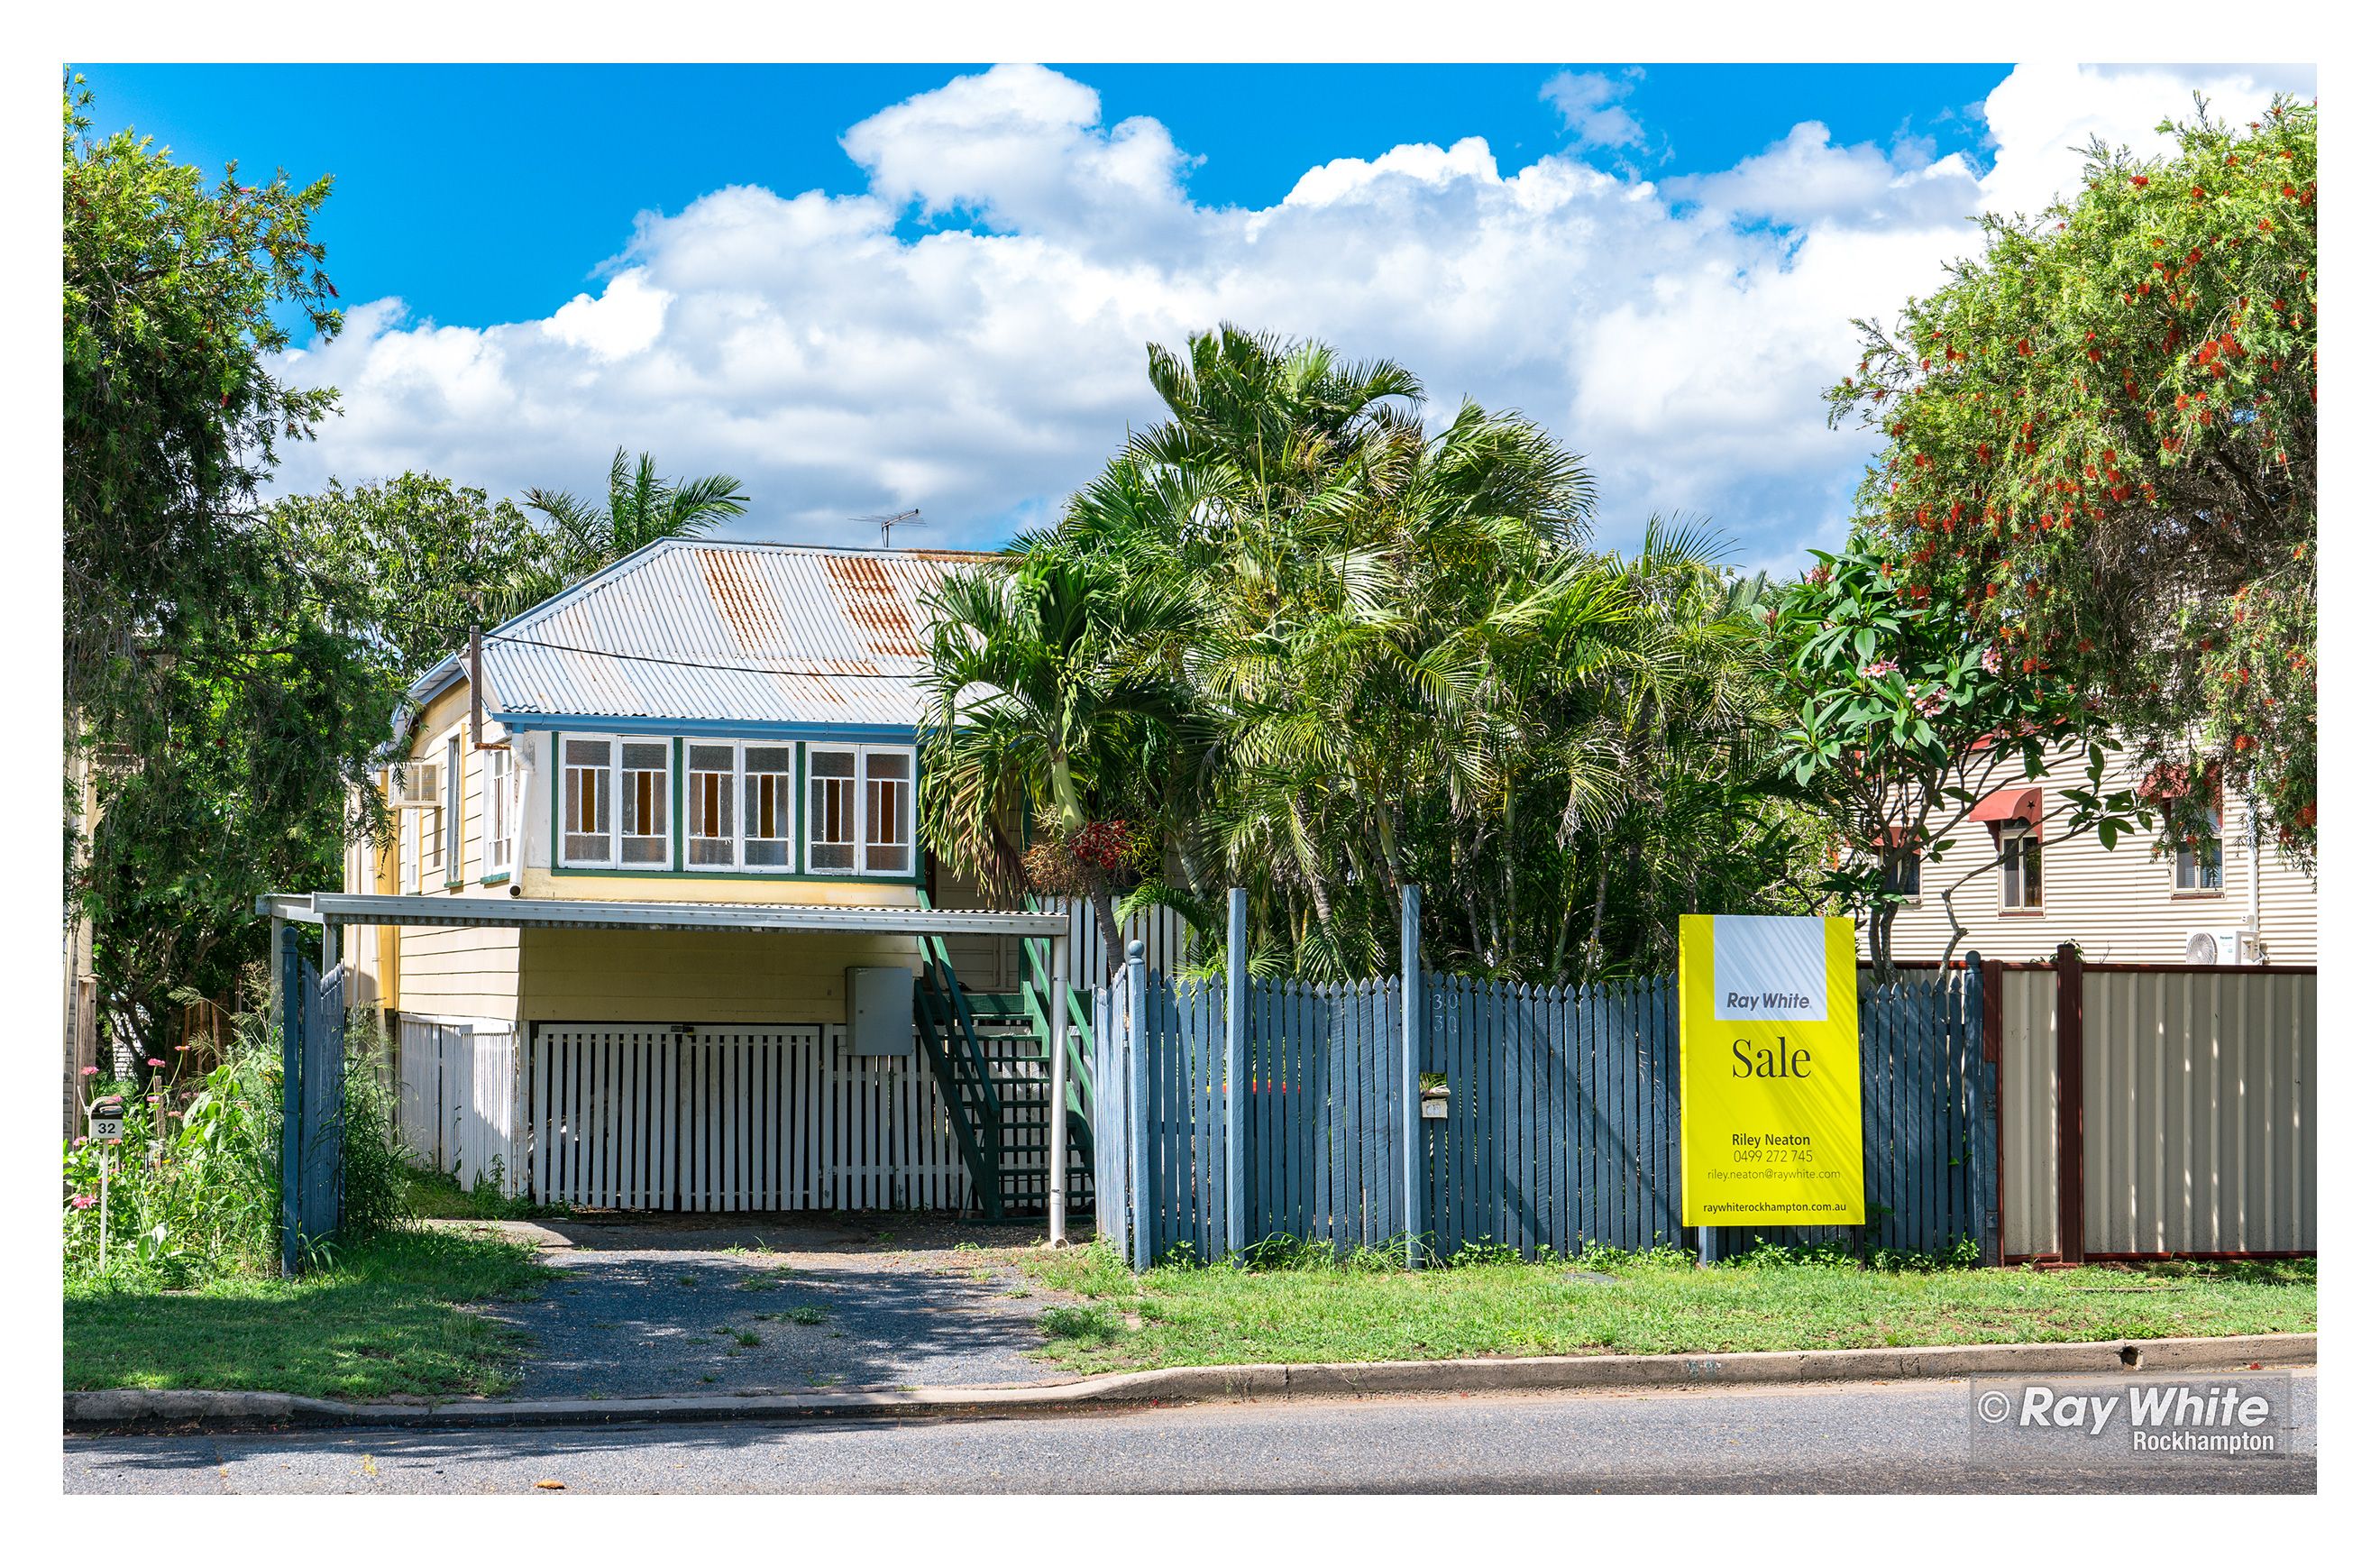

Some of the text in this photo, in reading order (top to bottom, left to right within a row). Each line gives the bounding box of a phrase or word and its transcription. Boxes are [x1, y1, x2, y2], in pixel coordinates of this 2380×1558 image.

[1433, 993, 1458, 1010] 30
[1726, 992, 1810, 1011] Ray White
[1733, 1036, 1811, 1078] Sale
[98, 1123, 115, 1133] 32
[1732, 1133, 1810, 1149] Riley Neaton
[1734, 1150, 1813, 1163] 0499 272 745
[1707, 1168, 1841, 1182] riley.neaton@raywhite.com
[1703, 1201, 1847, 1214] raywhiterockhampton.com.au
